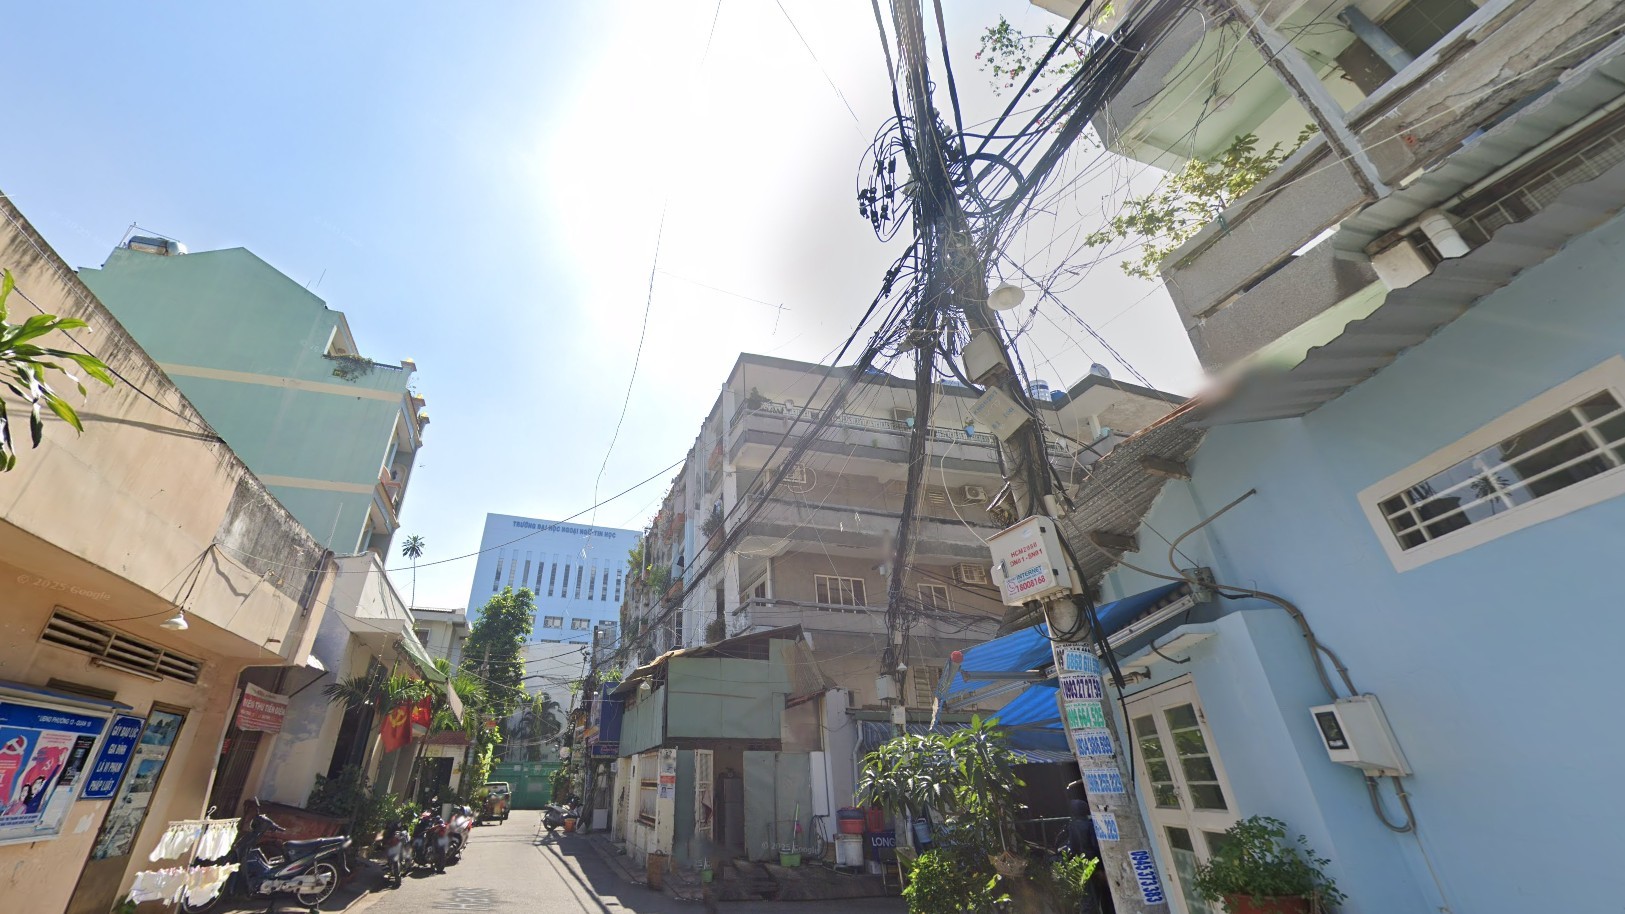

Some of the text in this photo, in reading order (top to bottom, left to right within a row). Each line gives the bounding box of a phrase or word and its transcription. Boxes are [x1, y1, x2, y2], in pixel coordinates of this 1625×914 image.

[549, 525, 560, 533] HỌC
[1016, 565, 1043, 580] INTERNET
[102, 761, 111, 773] VI
[108, 762, 123, 774] PHẠM
[88, 777, 115, 793] PHÁP LUẬT
[871, 837, 896, 847] LONG
